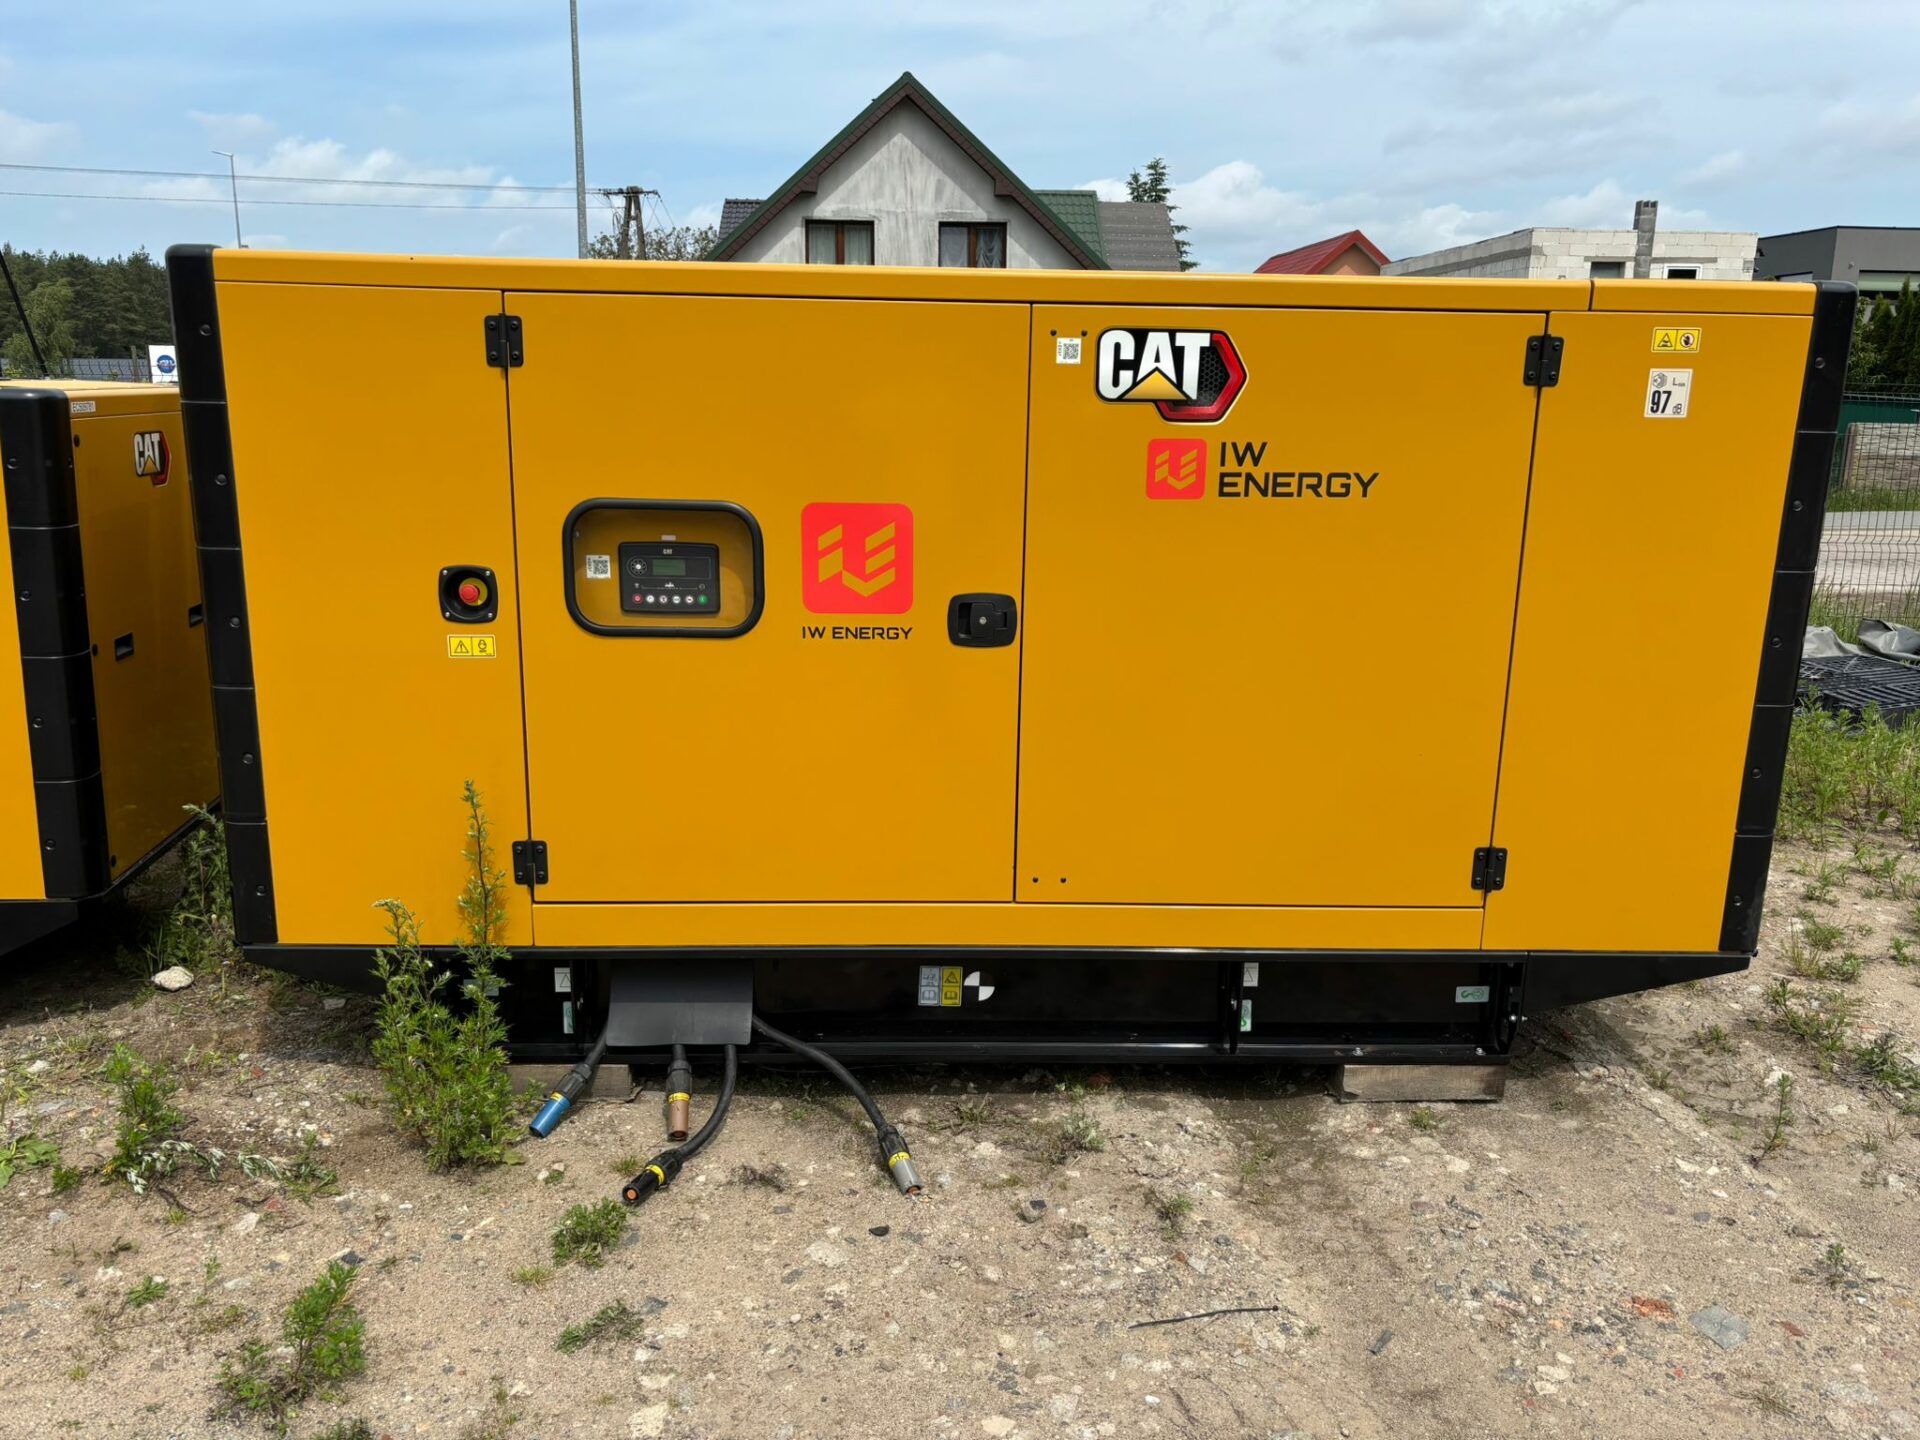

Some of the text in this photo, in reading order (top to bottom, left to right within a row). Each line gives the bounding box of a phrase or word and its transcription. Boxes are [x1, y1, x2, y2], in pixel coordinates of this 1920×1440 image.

[1098, 329, 1211, 400] CAT
[1650, 389, 1672, 414] 97
[134, 432, 160, 475] CAT
[1219, 442, 1267, 467] IW
[1218, 472, 1380, 498] ENERGY
[802, 626, 913, 640] IW ENERGY
